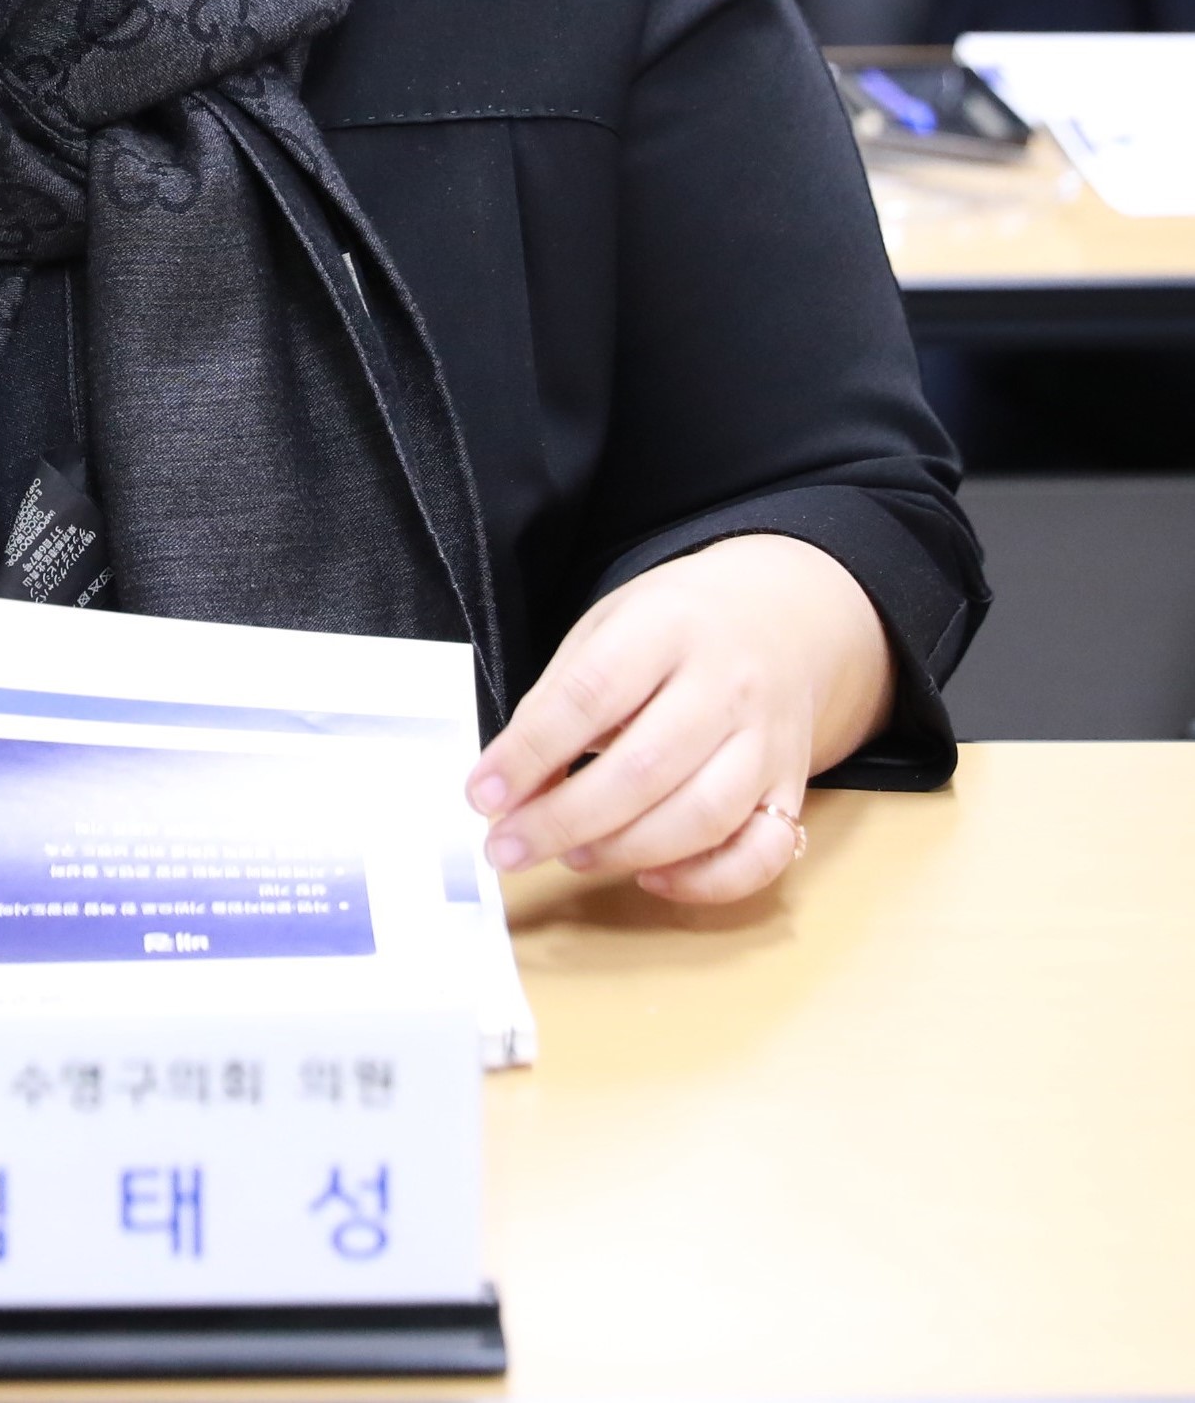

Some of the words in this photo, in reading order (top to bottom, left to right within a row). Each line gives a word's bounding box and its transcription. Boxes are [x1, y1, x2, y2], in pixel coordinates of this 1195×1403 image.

[22, 510, 44, 536] GUCCI
[12, 1057, 262, 1107] 수영구의회
[298, 1056, 396, 1107] 의원
[119, 1162, 205, 1258] 태
[310, 1162, 392, 1261] 성
